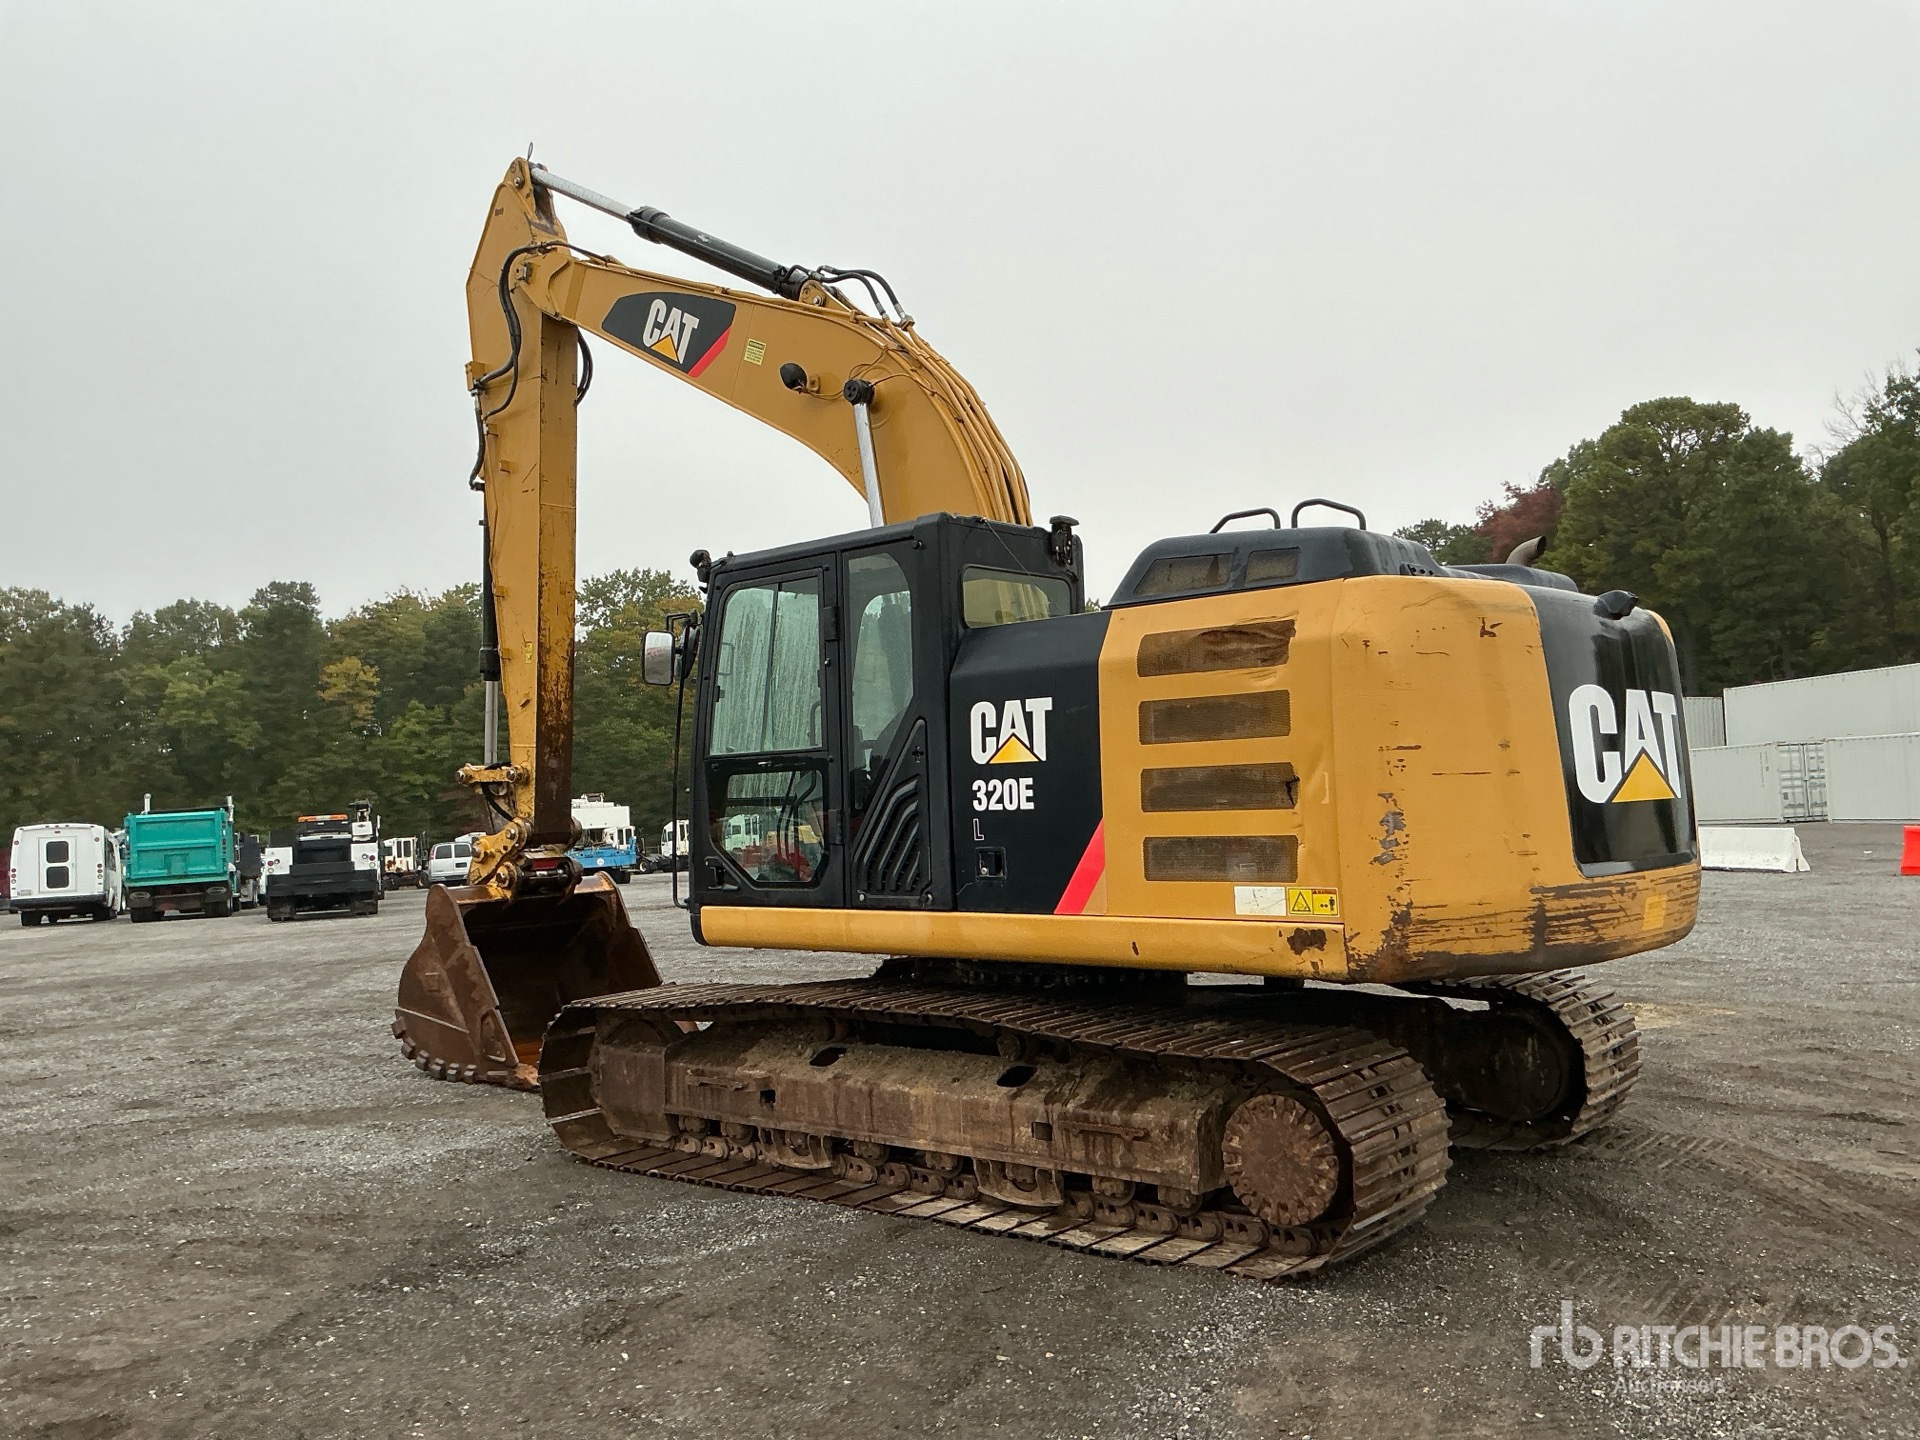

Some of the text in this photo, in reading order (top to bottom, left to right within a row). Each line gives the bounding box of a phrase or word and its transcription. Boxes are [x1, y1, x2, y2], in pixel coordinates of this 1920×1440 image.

[642, 299, 700, 364] CAT
[970, 697, 1053, 765] CAT
[1568, 684, 1682, 804] CAT
[972, 777, 1034, 811] 320E
[973, 818, 985, 841] L
